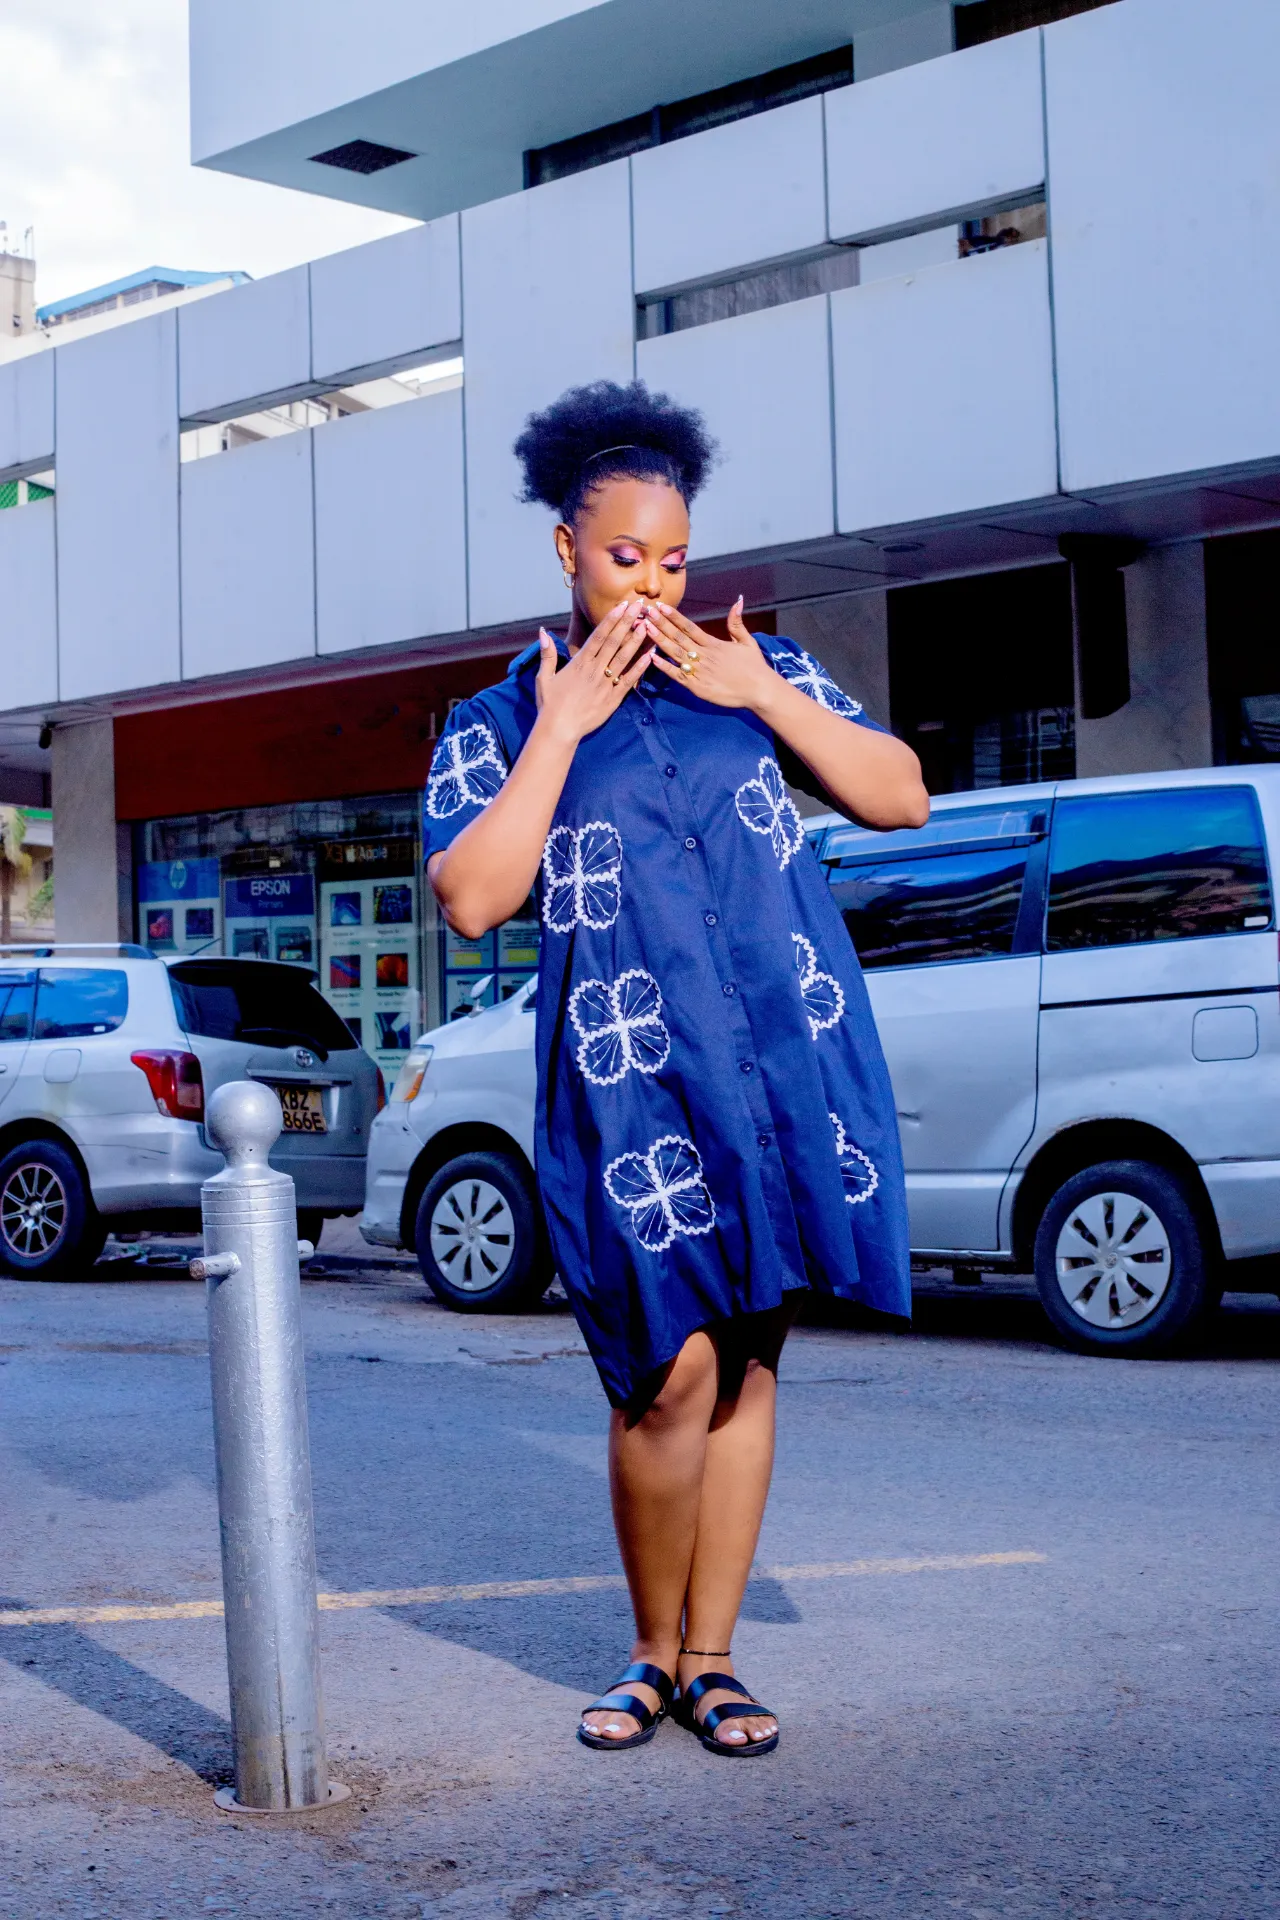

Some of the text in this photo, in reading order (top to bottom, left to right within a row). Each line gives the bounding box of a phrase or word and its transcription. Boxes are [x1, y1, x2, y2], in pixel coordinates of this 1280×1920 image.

[250, 879, 291, 896] EPSON
[279, 1088, 309, 1110] KBZ
[283, 1111, 324, 1131] 866E
